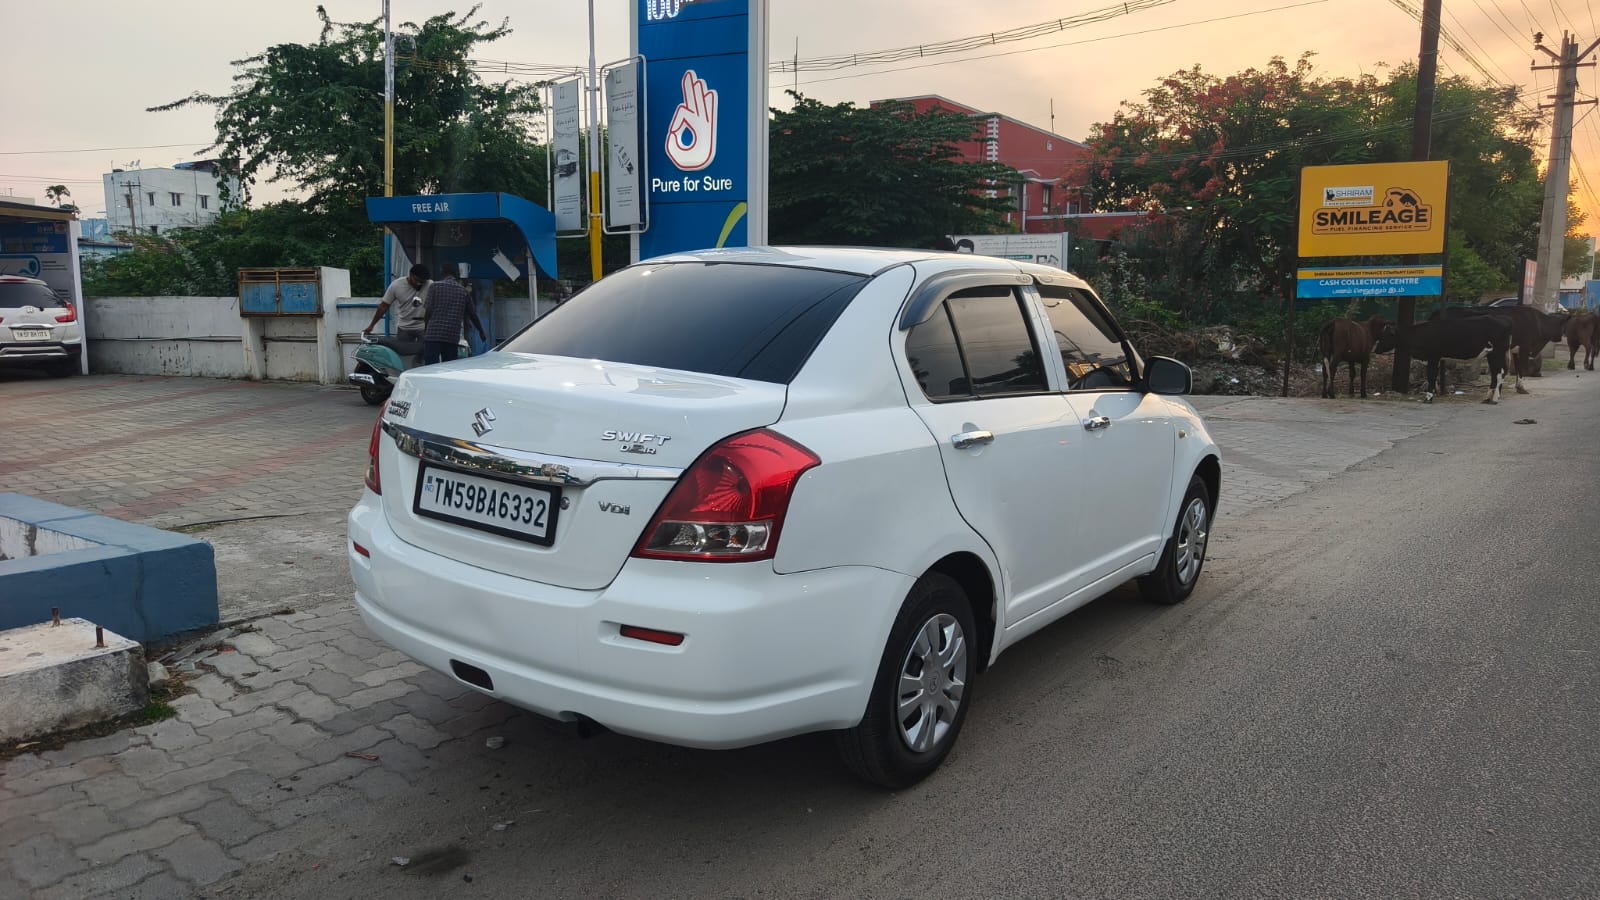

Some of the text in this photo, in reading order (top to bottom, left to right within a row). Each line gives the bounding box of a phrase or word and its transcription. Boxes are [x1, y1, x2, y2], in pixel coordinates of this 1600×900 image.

[652, 175, 733, 193] Pure for Sure
[1335, 189, 1373, 197] SHRIRAM
[411, 202, 449, 213] FREE AIR
[1316, 208, 1428, 226] SMILEAGE
[601, 430, 671, 446] SWIFT
[435, 477, 546, 528] TN59BA6332
